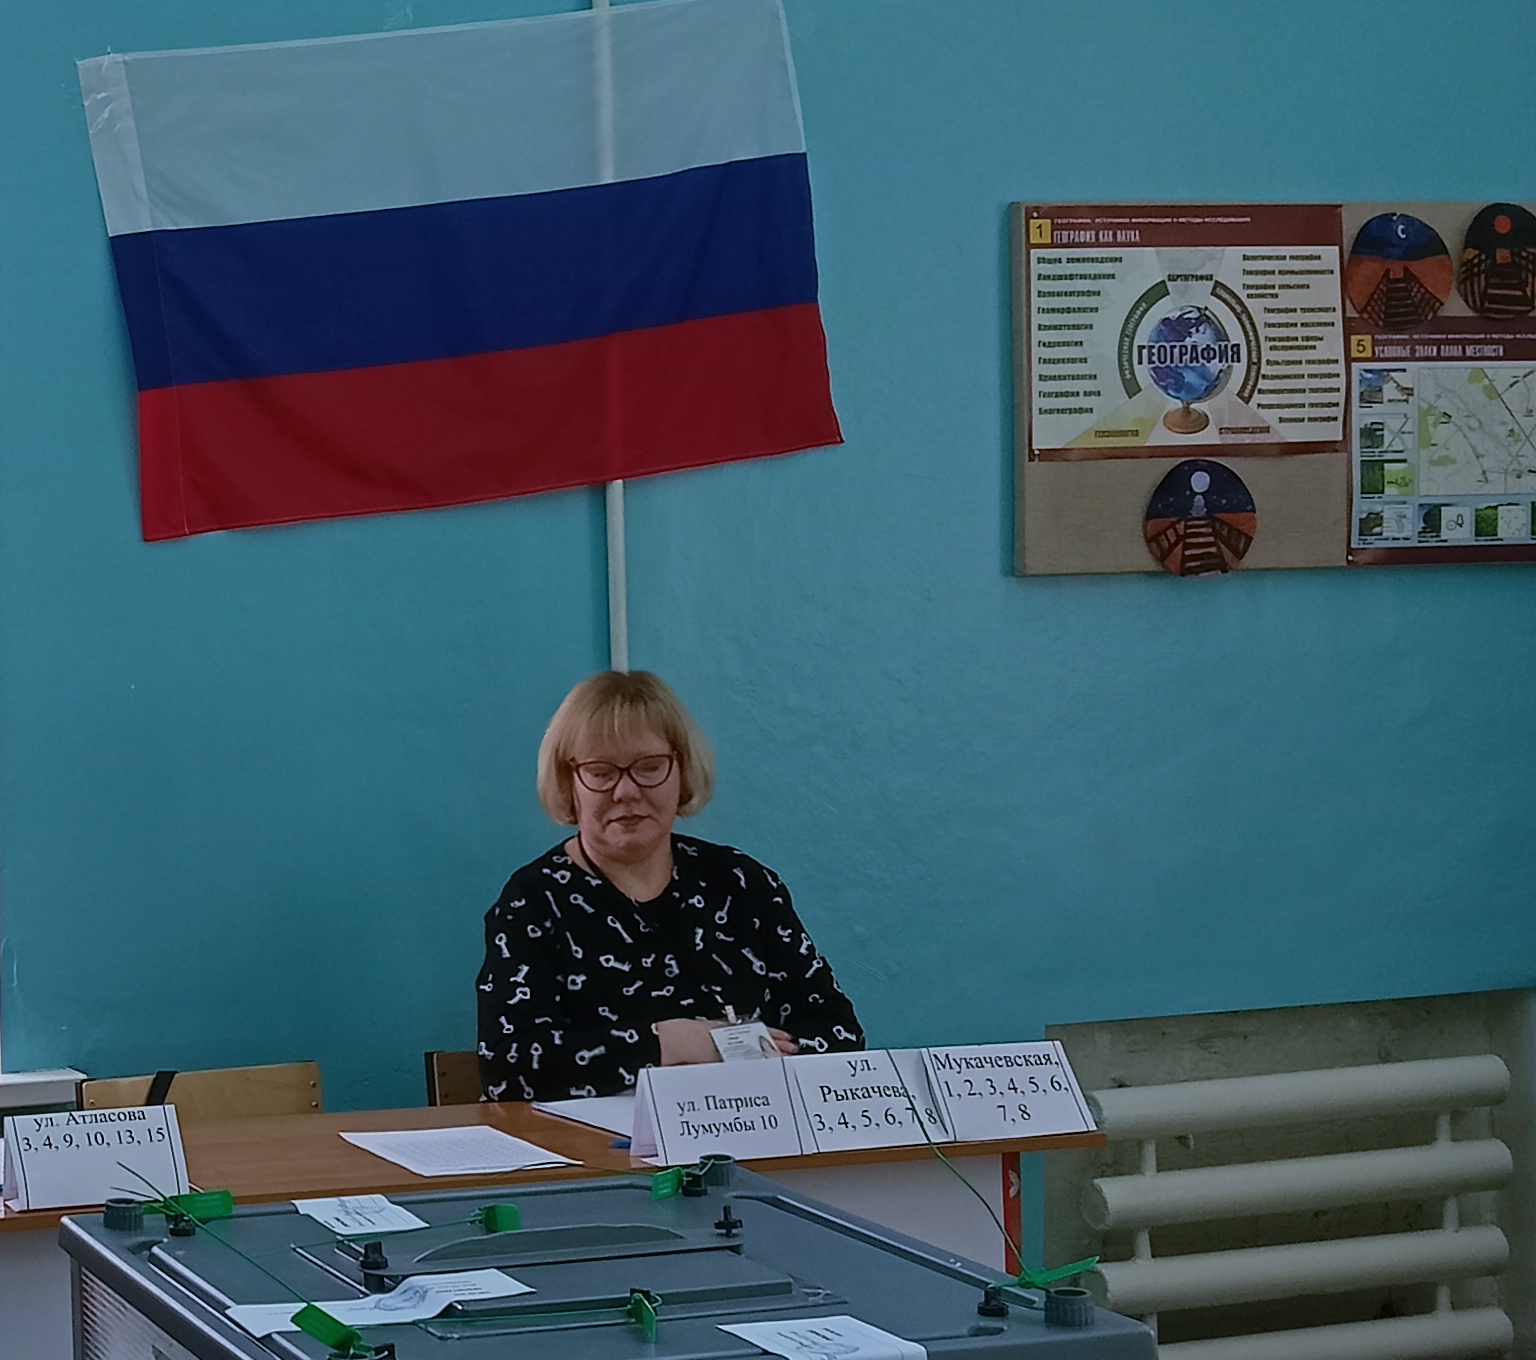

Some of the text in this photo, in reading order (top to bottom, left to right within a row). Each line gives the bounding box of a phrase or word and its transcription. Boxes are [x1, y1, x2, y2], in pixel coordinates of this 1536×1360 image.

[1137, 343, 1241, 366] ГЕОГРАФИЯ
[1356, 339, 1366, 353] 5
[846, 1059, 877, 1077] ул.
[933, 1053, 1059, 1074] Мукачевская,
[818, 1085, 916, 1102] Рыкачева,
[944, 1074, 1069, 1099] 1, 2, 3, 4, 5, 6,
[677, 1095, 770, 1116] ул. Патриса
[33, 1110, 146, 1132] ул. Атласова
[680, 1114, 778, 1139] Лумумбы 10
[813, 1113, 834, 1133] 3,
[837, 1112, 857, 1132] 4,
[861, 1109, 880, 1129] 5,
[884, 1107, 903, 1128] 6,
[925, 1107, 937, 1124] 8
[22, 1127, 165, 1153] 3, 4, 9, 10, 13, 15
